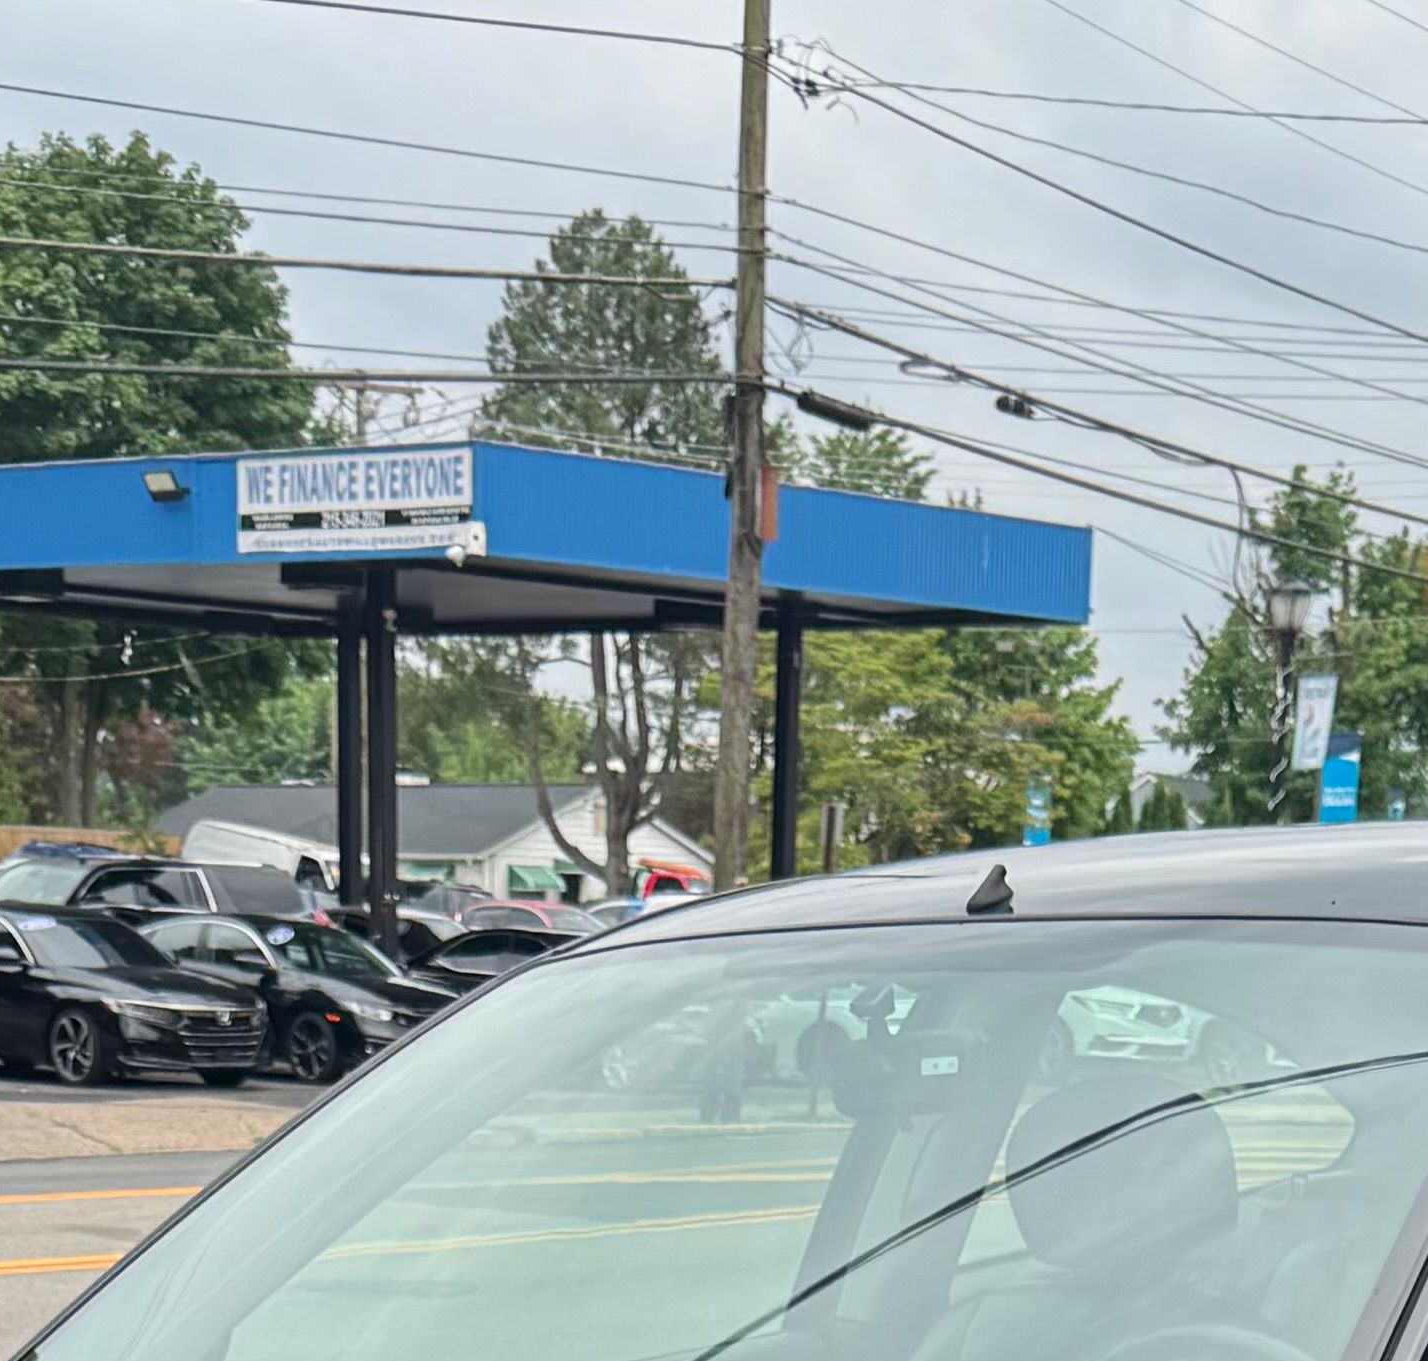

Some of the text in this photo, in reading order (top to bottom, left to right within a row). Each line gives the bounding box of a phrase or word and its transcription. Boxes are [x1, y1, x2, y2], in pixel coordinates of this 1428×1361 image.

[245, 455, 465, 505] WE FINANCE EVERYONE
